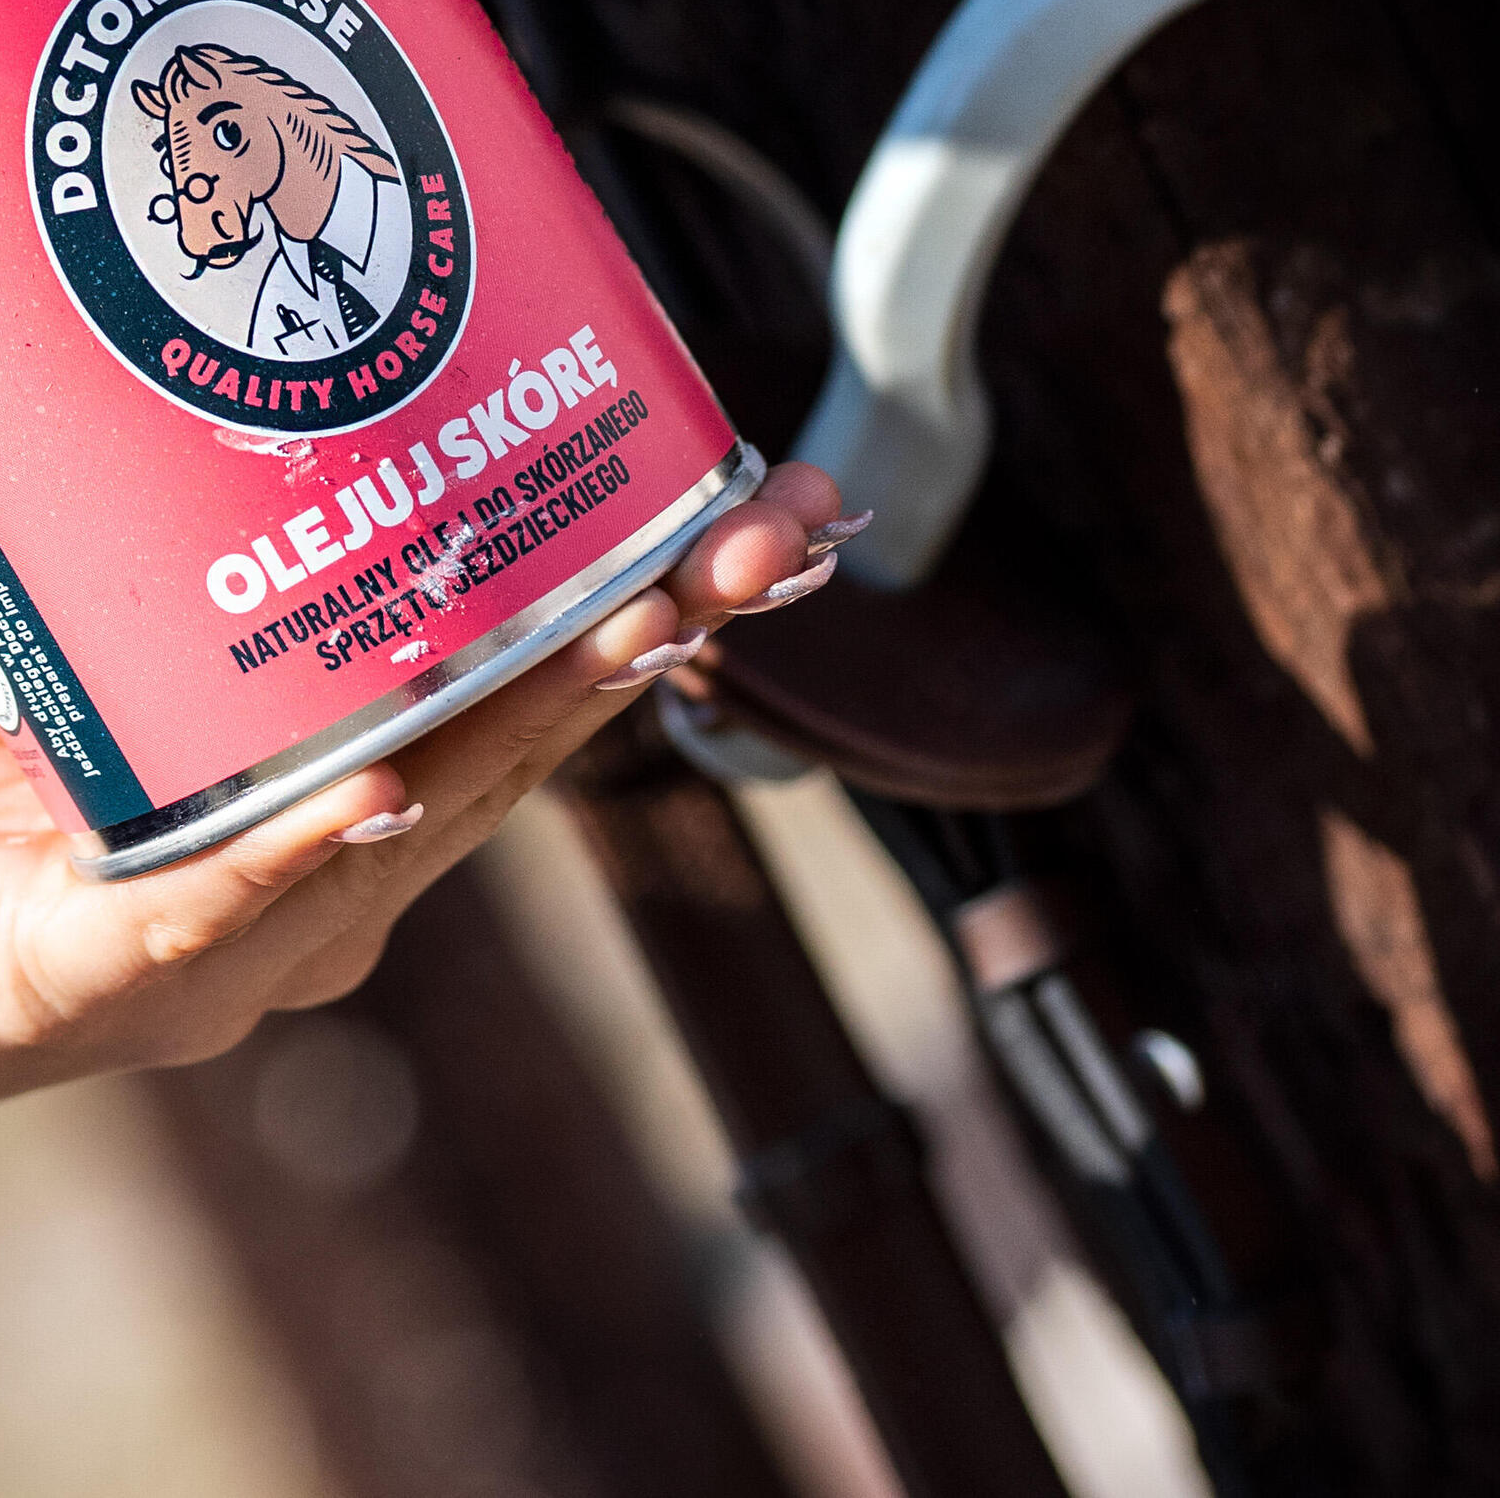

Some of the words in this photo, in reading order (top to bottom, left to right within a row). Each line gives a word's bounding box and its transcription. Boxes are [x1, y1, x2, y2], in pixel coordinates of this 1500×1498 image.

[161, 338, 334, 411] QUALITY
[346, 288, 448, 400] HORSE
[420, 173, 454, 277] CARE
[206, 441, 446, 614] OLEJUJ
[438, 324, 617, 479] SKÓRĘ
[229, 556, 398, 673] NATURALNY
[472, 486, 516, 530] DO
[513, 389, 649, 503] SKÓRZANEGO
[452, 454, 631, 594] JEŹDZIECKIEGO
[0, 646, 15, 668] w
[14, 618, 34, 642] do
[11, 670, 48, 723] długo
[19, 657, 101, 778] jeździeckiego
[28, 644, 85, 722] preparat
[43, 726, 71, 758] Aby
